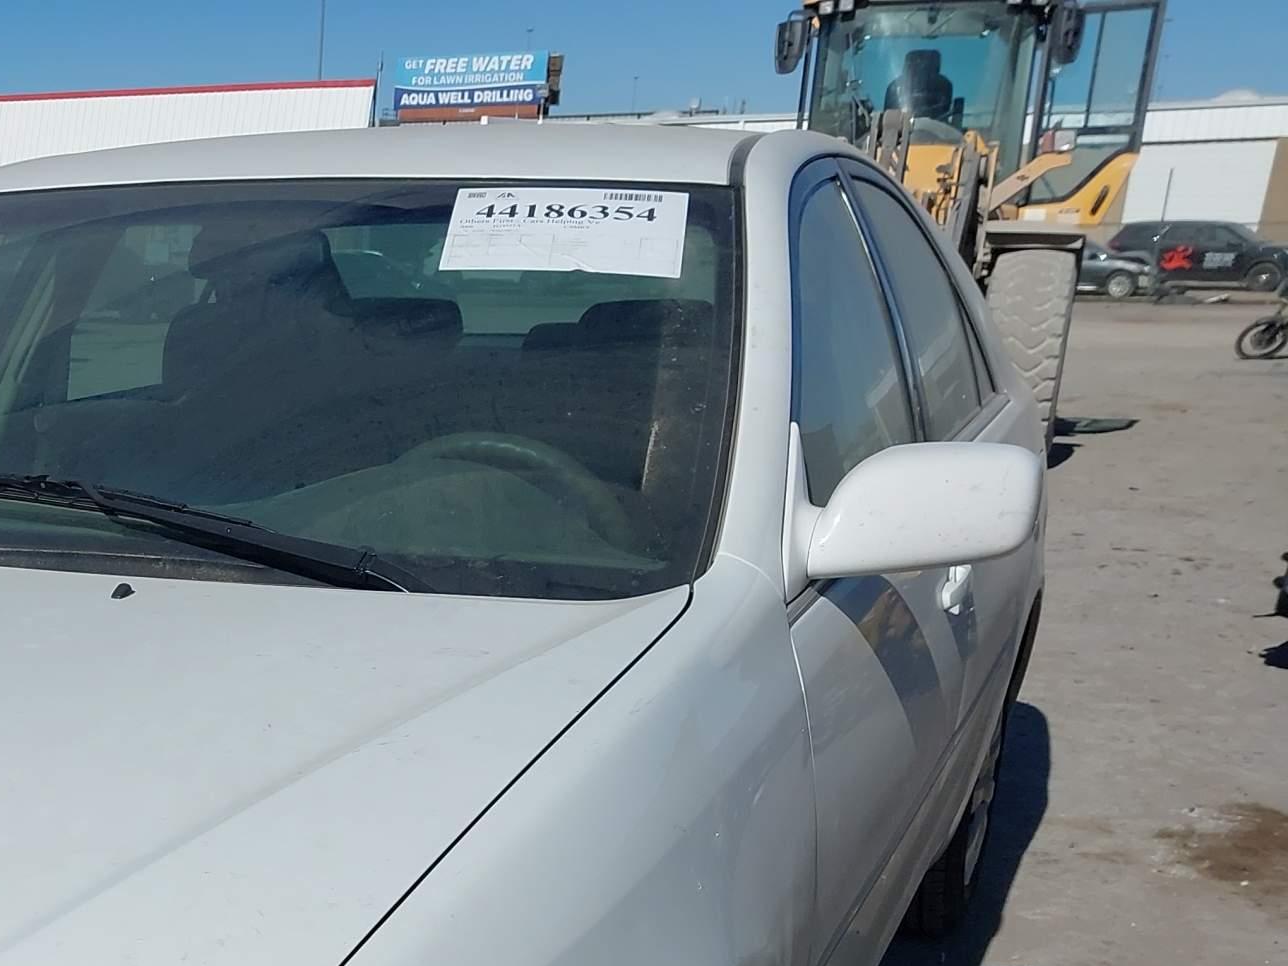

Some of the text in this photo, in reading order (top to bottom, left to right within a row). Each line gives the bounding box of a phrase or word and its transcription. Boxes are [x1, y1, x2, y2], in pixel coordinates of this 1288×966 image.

[405, 54, 534, 74] GET FREE WATER
[412, 71, 524, 86] FOR LAWN IRRIGATION
[400, 88, 533, 106] AQUA WELL DRILLING
[475, 203, 657, 222] 44186354
